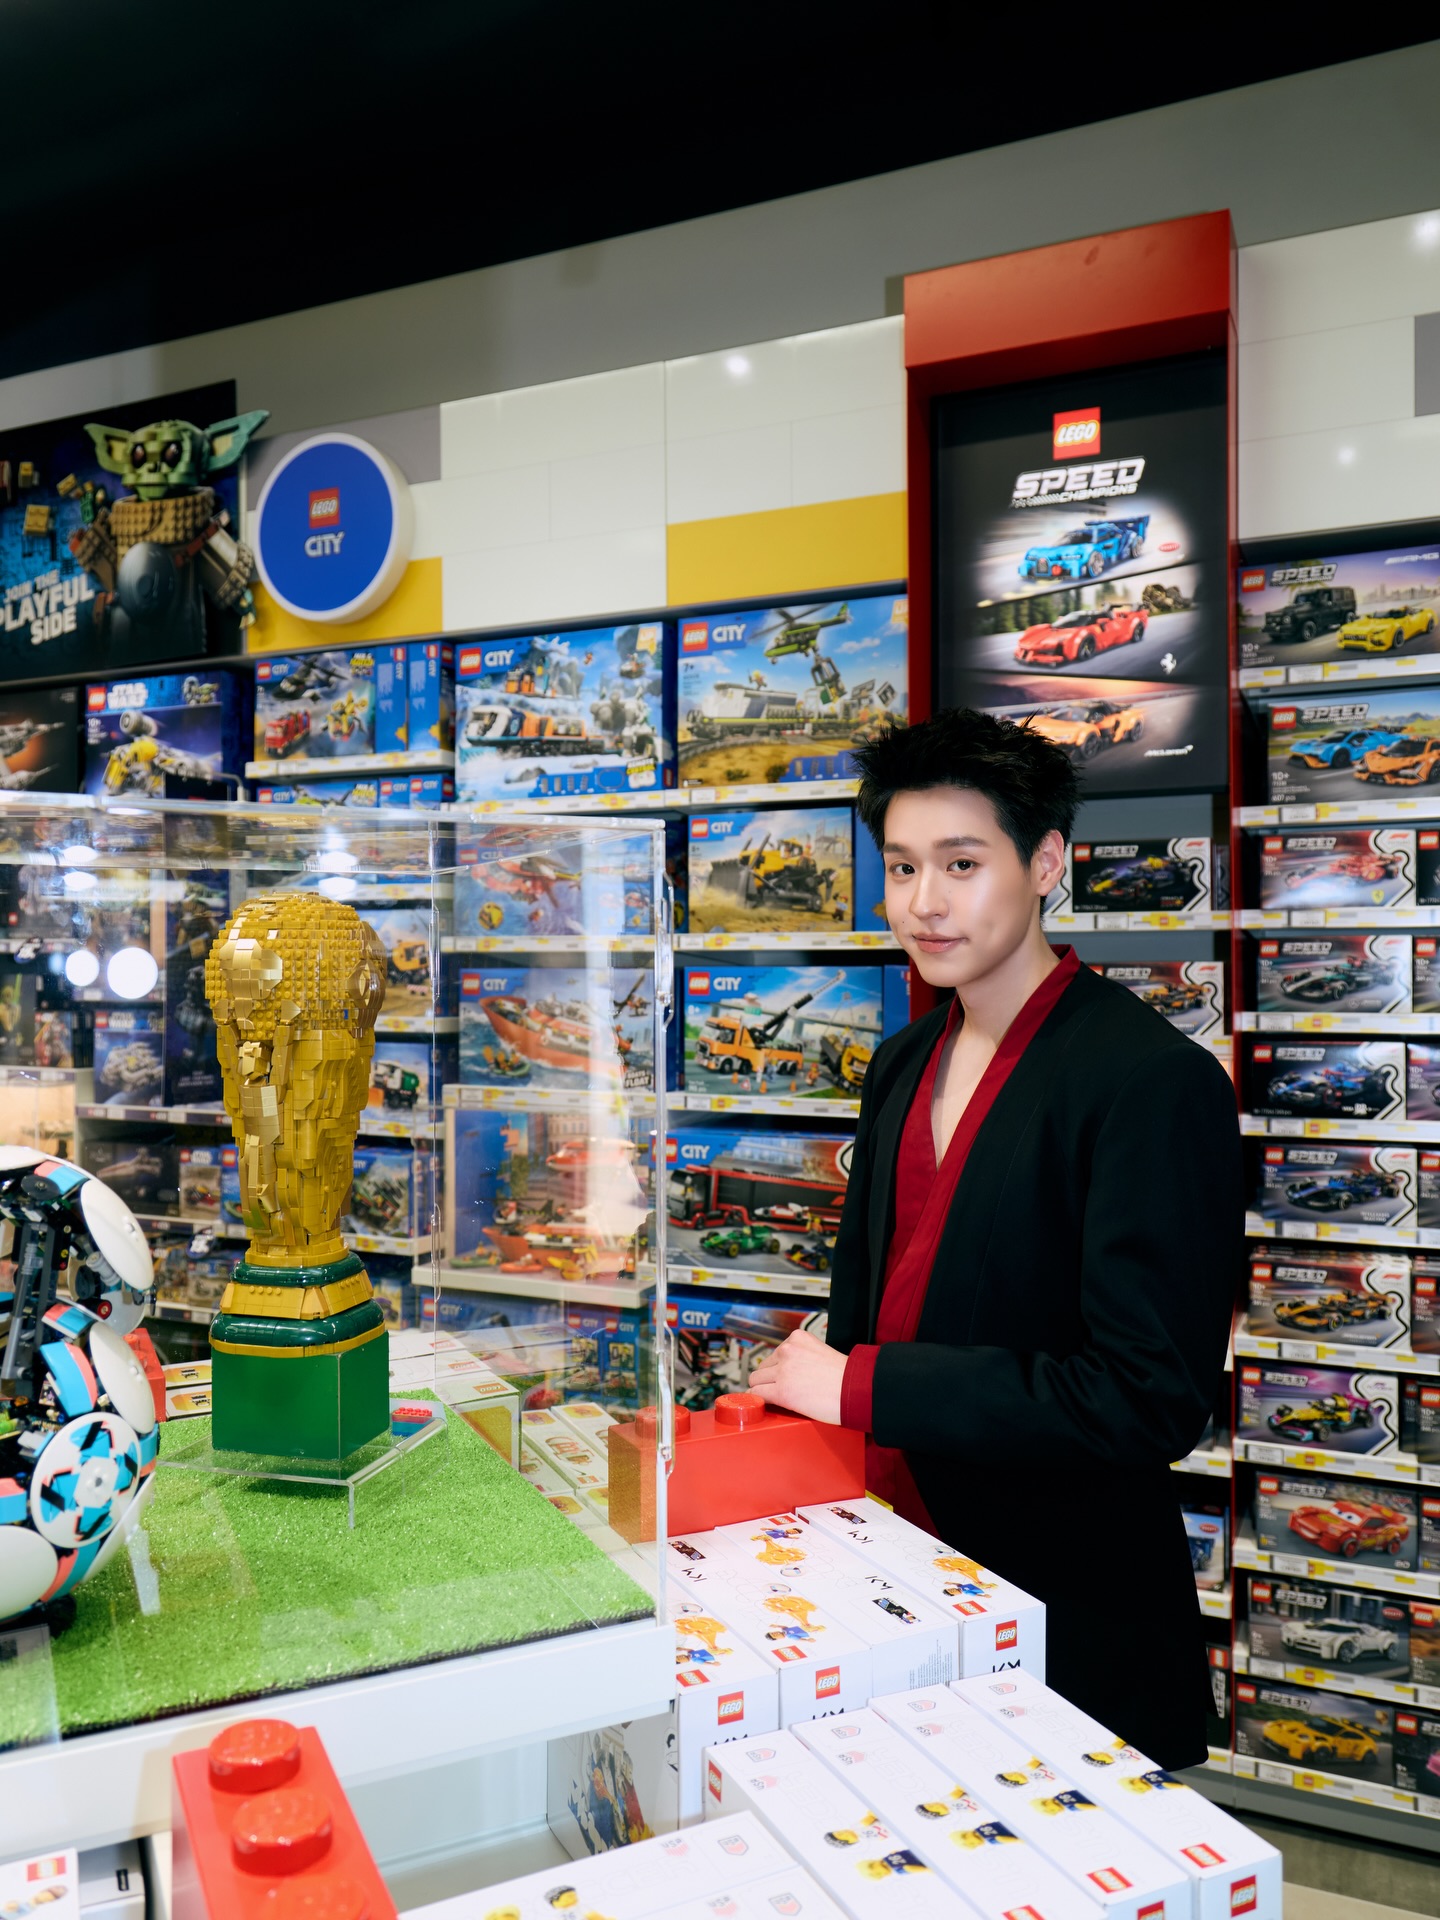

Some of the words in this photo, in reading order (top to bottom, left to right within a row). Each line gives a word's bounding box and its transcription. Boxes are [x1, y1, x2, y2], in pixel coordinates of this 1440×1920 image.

[1057, 421, 1097, 444] LEGO
[1012, 456, 1146, 500] SPEED
[1059, 483, 1138, 503] CHAMPIONS
[310, 498, 339, 517] LEGO
[304, 531, 345, 558] CITY
[1243, 575, 1263, 586] LEGO
[1271, 564, 1337, 583] SPEED
[3, 580, 33, 603] JOIN
[34, 568, 60, 591] THE
[30, 605, 77, 645] SIDE
[684, 630, 708, 644] LEGO
[712, 624, 746, 643] CITY
[460, 653, 481, 666] LEGO
[484, 649, 514, 668] CITY
[272, 664, 290, 674] CITY
[683, 663, 694, 672] 7+
[1273, 713, 1294, 723] LEGO
[1303, 704, 1370, 721] SPEED
[711, 821, 733, 833] CITY
[1287, 837, 1337, 848] SPEED
[1283, 942, 1333, 953] SPEED
[484, 978, 508, 991] CITY
[713, 977, 742, 991] CITY
[681, 1144, 710, 1159] CITY
[1288, 1150, 1338, 1162] SPEED
[1276, 1267, 1327, 1281] SPEED
[682, 1311, 711, 1326] CITY
[620, 1324, 636, 1333] CITY
[1276, 1589, 1327, 1608] SPEED
[997, 1627, 1017, 1643] LEGO
[817, 1676, 839, 1691] LEGO
[719, 1699, 743, 1716] LEGO
[1232, 1885, 1256, 1908] LEGO
